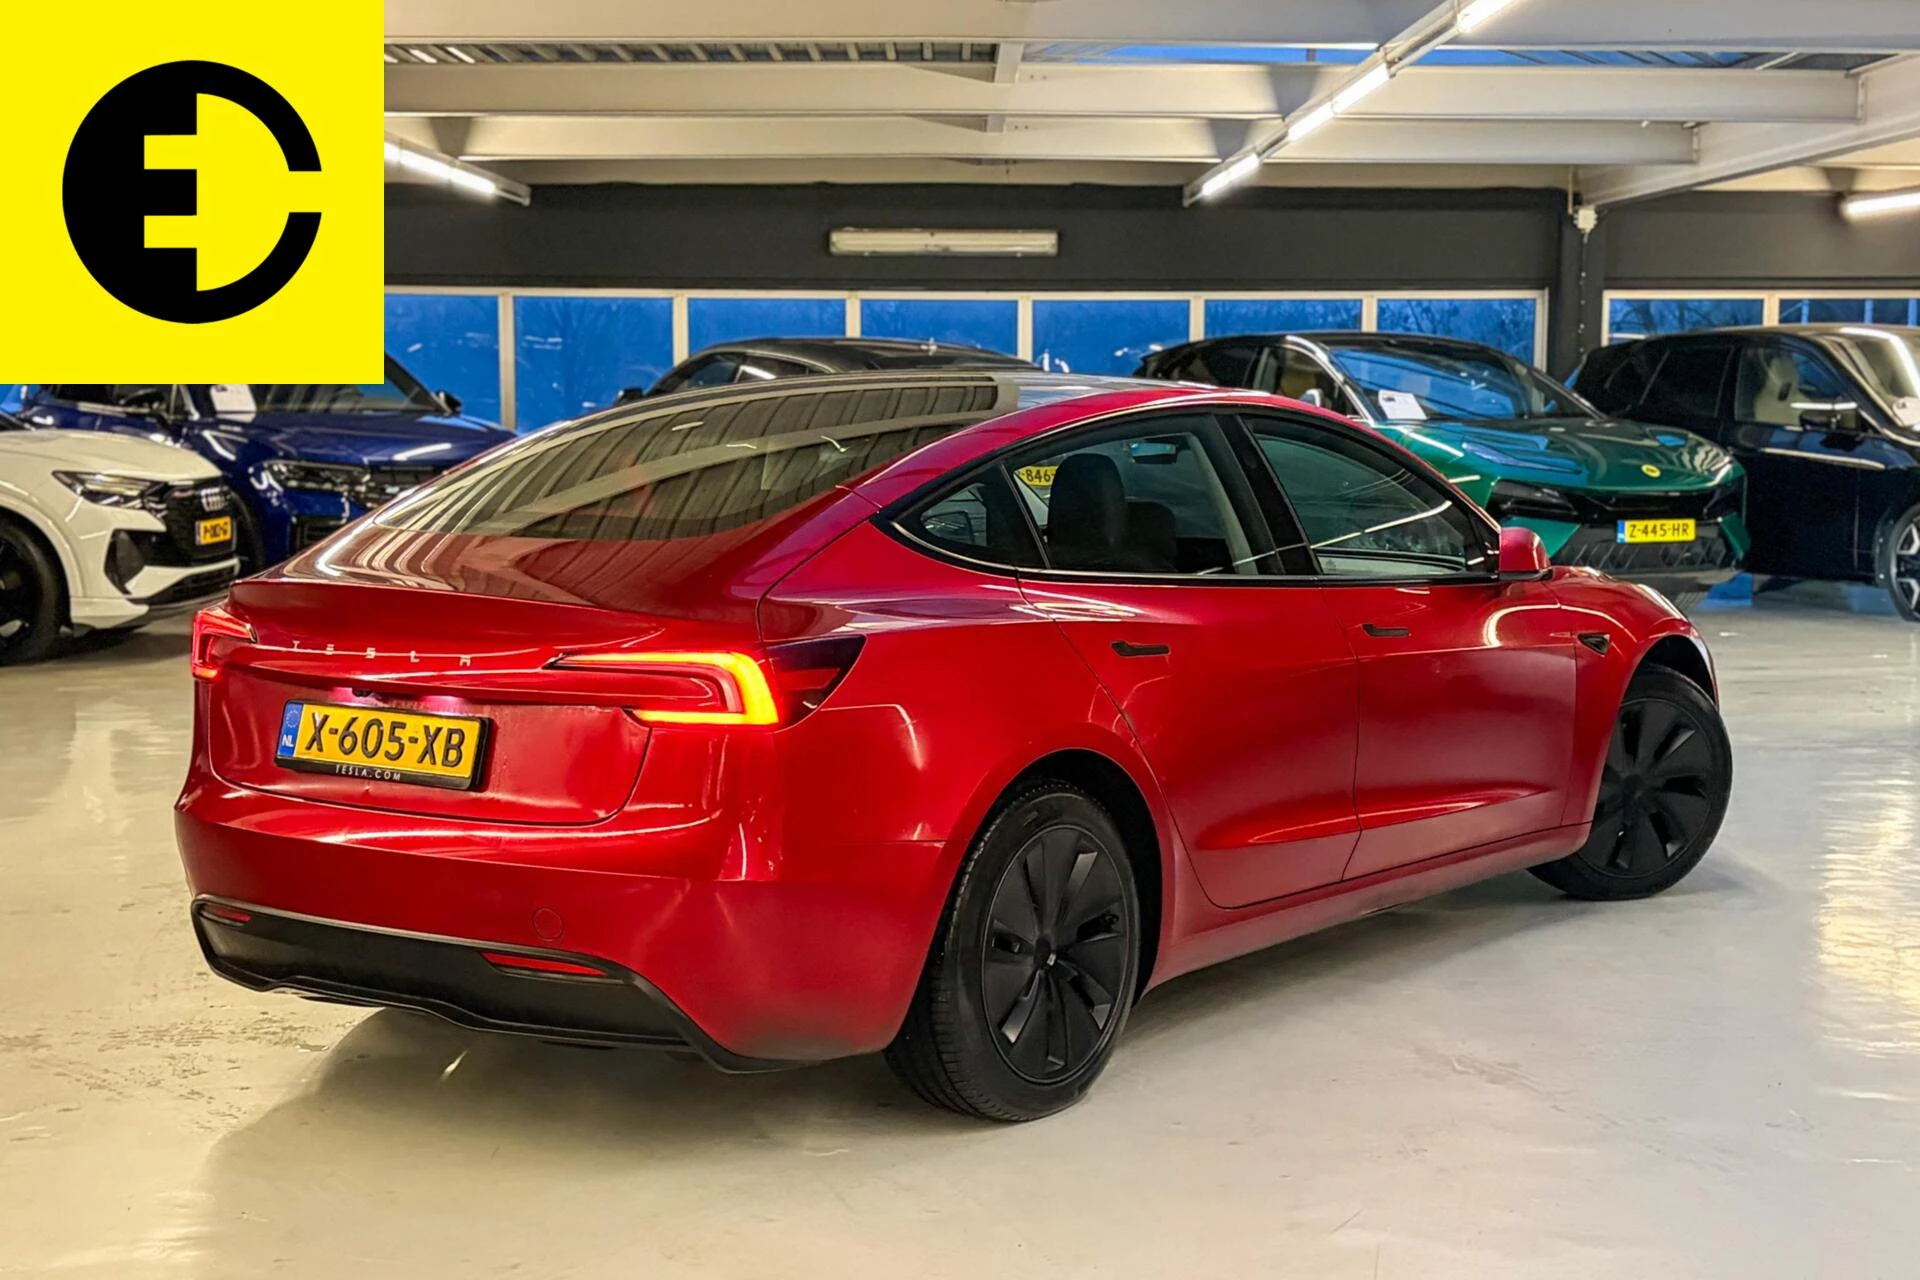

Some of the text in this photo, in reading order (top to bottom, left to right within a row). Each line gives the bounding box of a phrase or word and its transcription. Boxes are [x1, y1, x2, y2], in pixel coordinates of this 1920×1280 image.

[1628, 522, 1690, 538] Z-445-HR
[292, 640, 471, 667] TESLA
[281, 734, 294, 748] NL
[304, 711, 466, 768] X-605-XB
[335, 763, 401, 781] TESLA.COM
